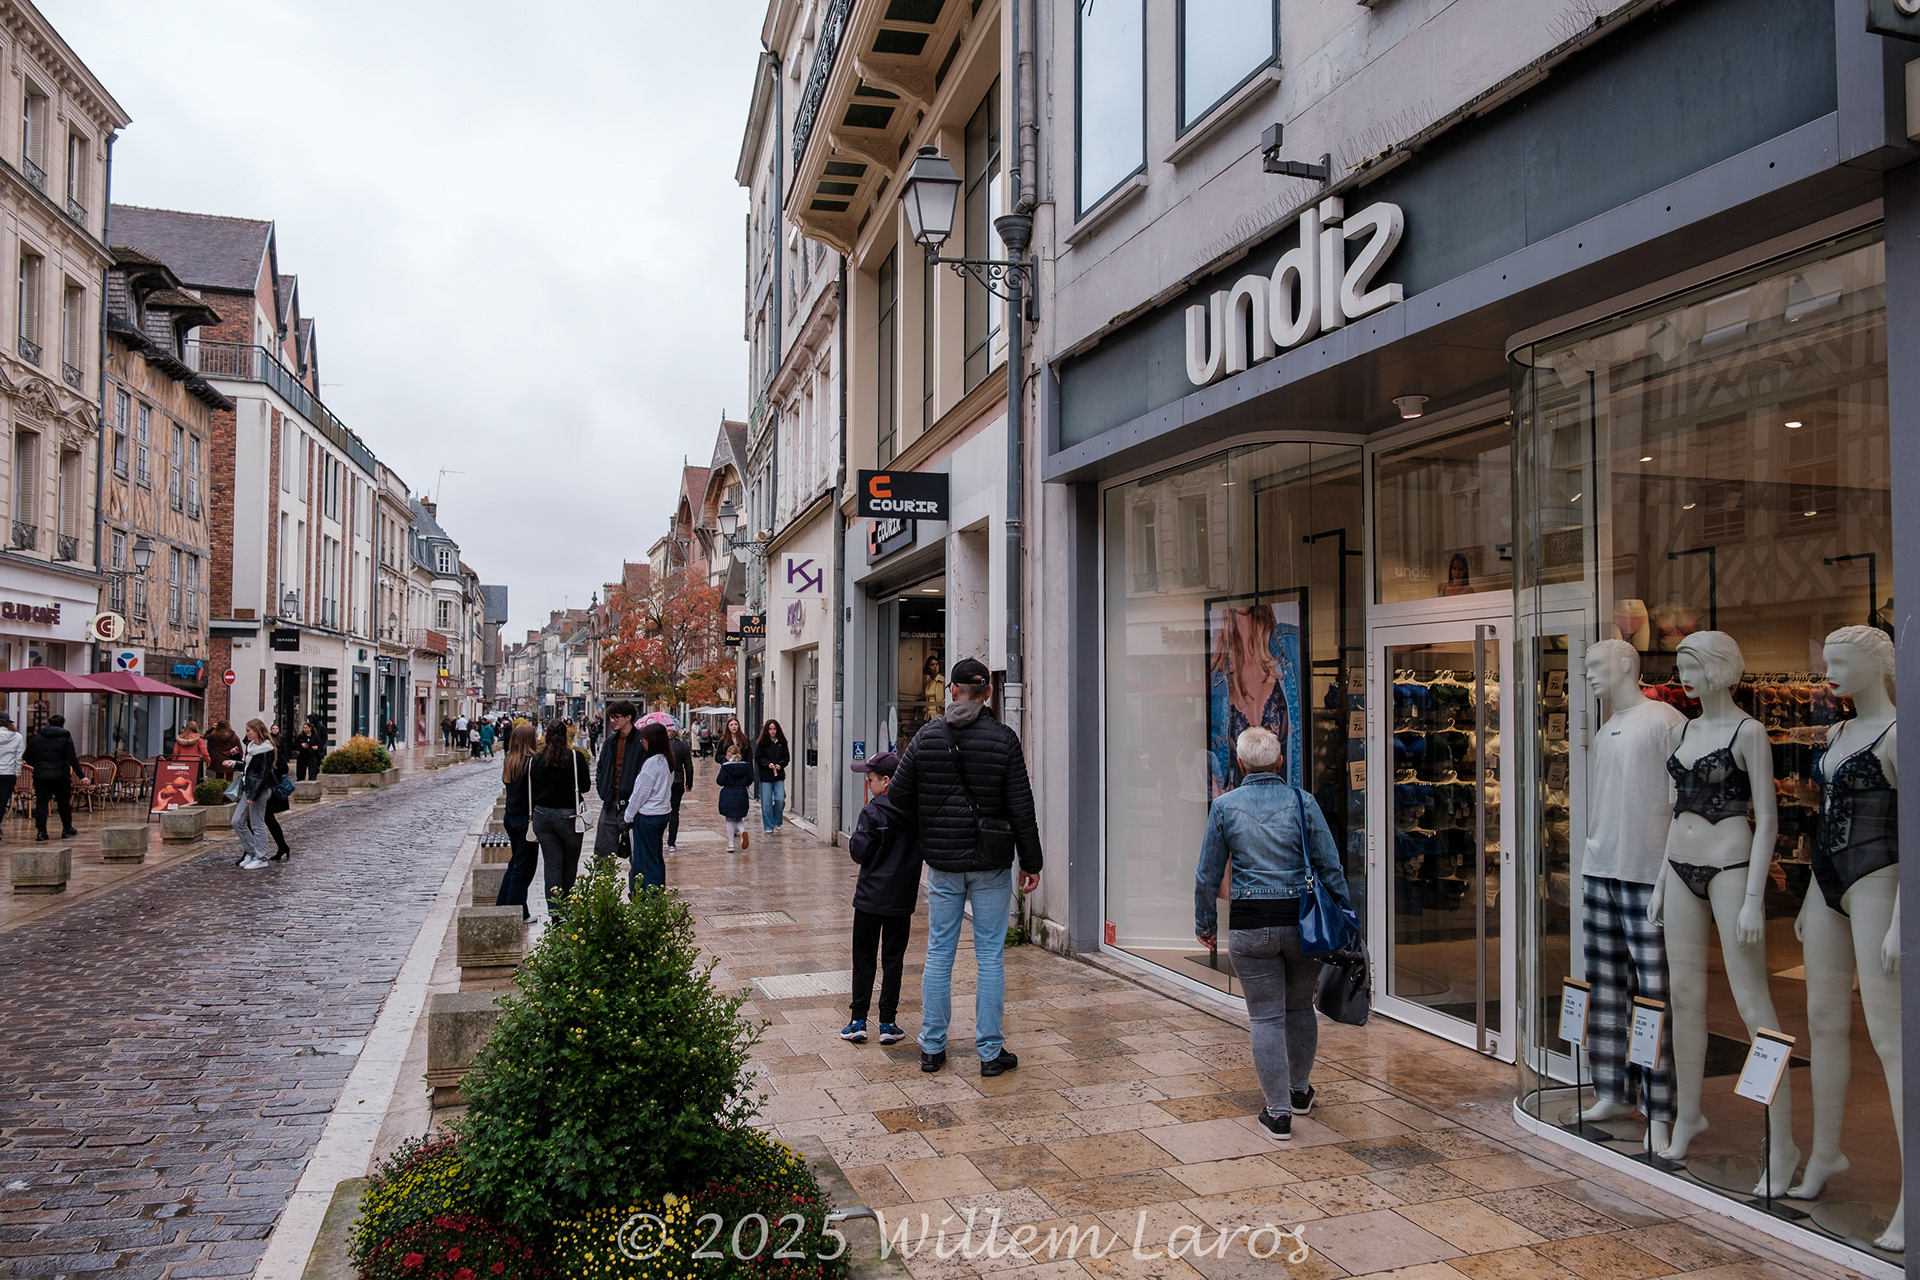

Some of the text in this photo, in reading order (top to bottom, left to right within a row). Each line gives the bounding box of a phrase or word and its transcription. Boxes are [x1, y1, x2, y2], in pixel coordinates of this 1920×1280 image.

[1186, 196, 1404, 386] undiz
[869, 499, 938, 513] COURIR
[1395, 564, 1431, 578] undiz
